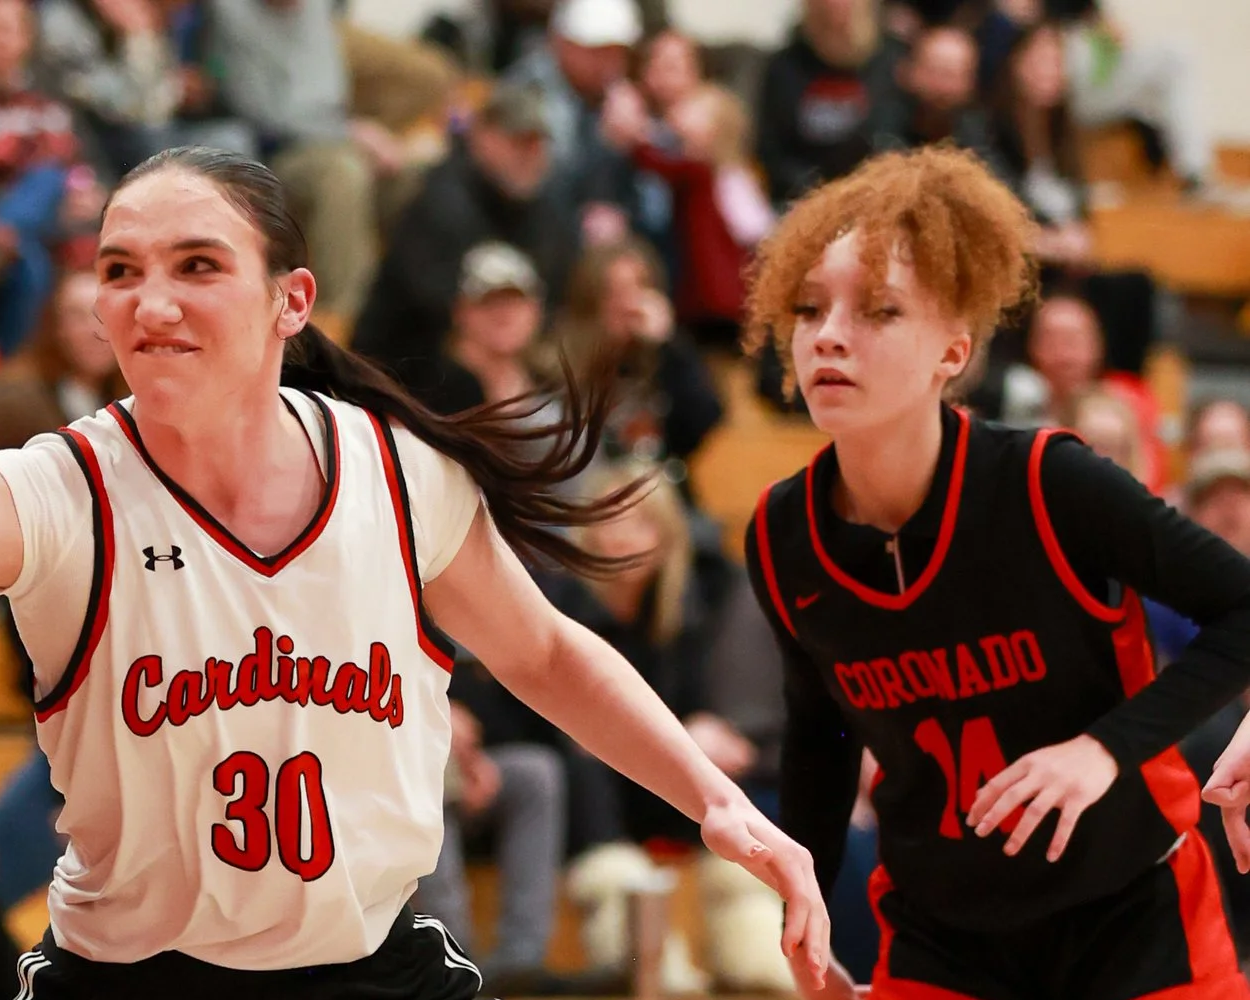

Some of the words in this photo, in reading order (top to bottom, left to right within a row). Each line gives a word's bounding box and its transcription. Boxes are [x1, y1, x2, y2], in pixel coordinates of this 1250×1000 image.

[121, 626, 404, 737] Cardinals
[833, 628, 1048, 710] CORONADO
[211, 751, 335, 882] 30
[913, 715, 1028, 840] 14
